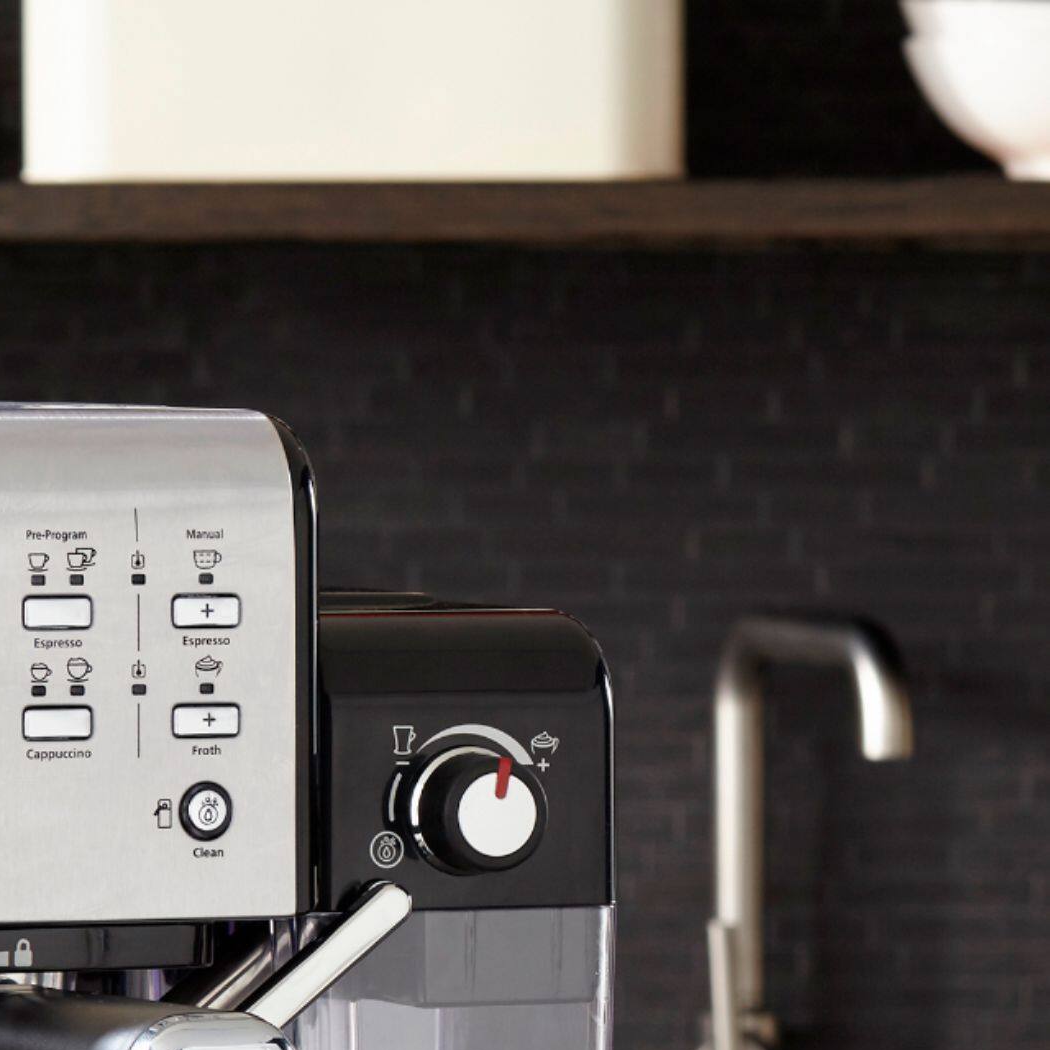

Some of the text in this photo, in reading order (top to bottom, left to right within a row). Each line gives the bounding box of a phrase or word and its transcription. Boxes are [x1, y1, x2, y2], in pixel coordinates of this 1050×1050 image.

[25, 529, 88, 543] Pre-Program
[186, 529, 224, 540] Manual
[33, 637, 83, 650] Espresso
[182, 635, 231, 648] Espresso
[25, 747, 93, 762] Cappuccino
[191, 744, 222, 756] Froth
[192, 847, 224, 859] Clean
